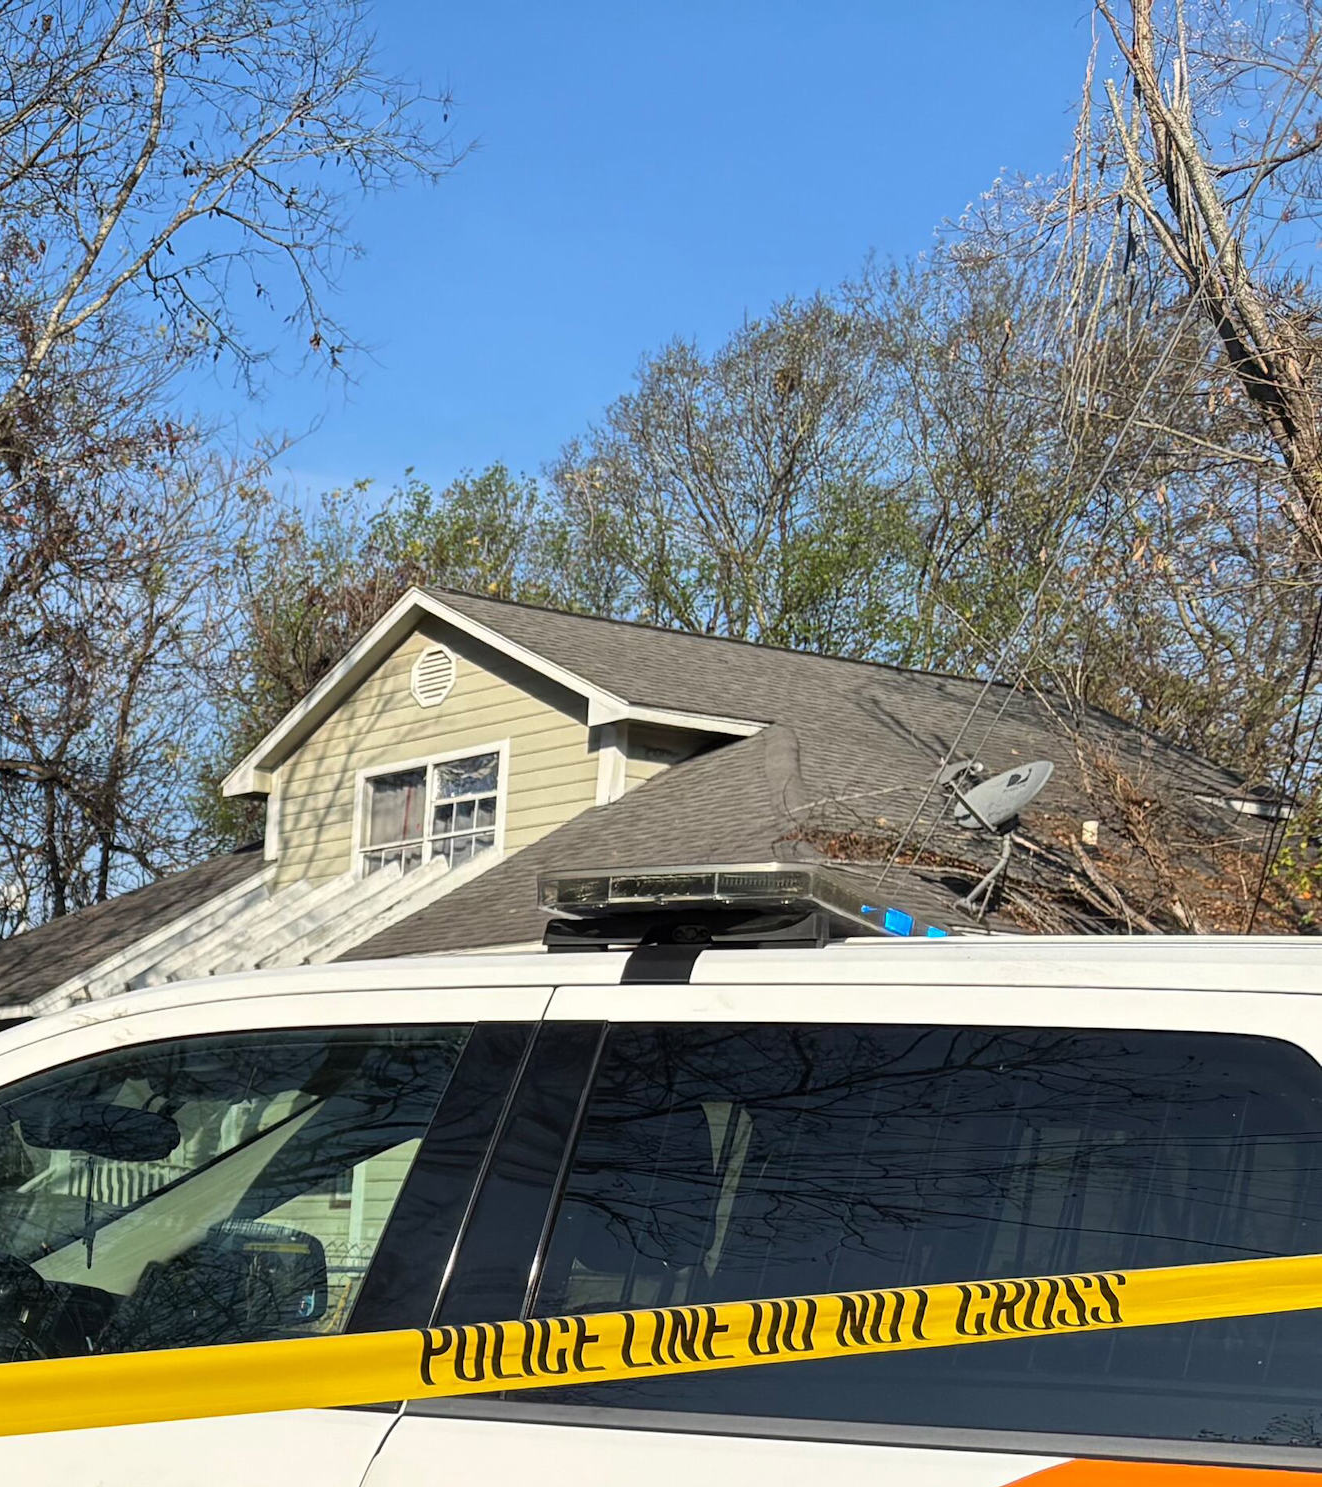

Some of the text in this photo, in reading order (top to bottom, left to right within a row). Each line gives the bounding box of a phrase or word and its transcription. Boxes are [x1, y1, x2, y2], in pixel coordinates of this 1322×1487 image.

[420, 1272, 1126, 1385] POLICE LINE DO NOT CROSS
